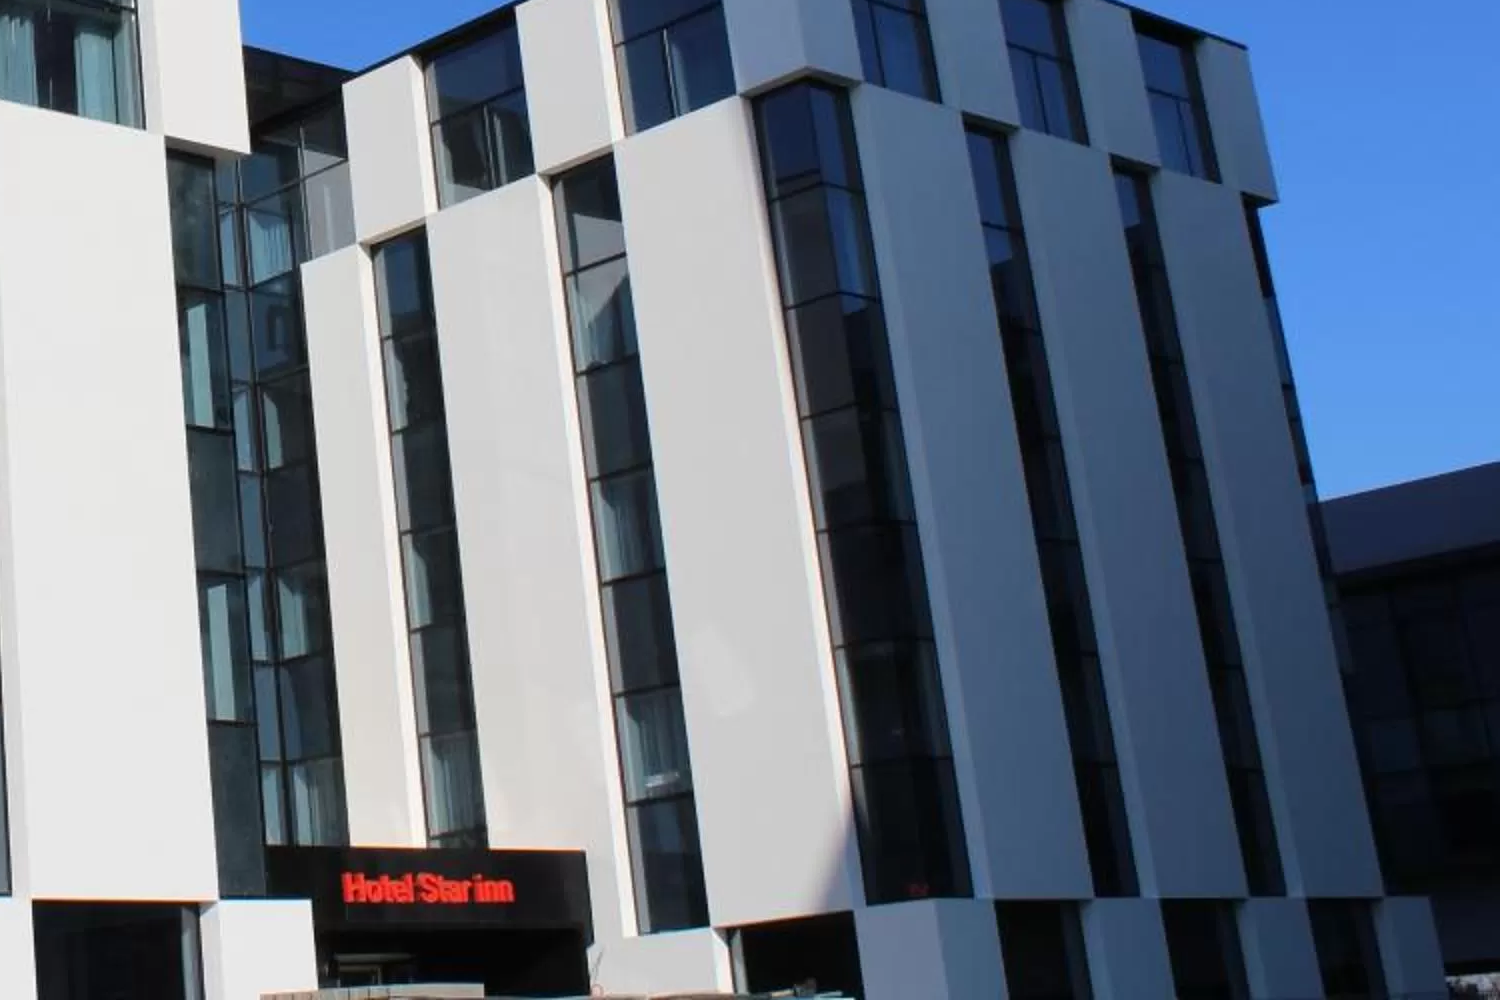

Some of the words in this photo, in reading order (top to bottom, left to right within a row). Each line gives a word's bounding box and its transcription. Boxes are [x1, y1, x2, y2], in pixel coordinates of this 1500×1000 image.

[342, 872, 414, 903] Hotel
[418, 872, 472, 903] Star
[473, 873, 515, 903] inn
